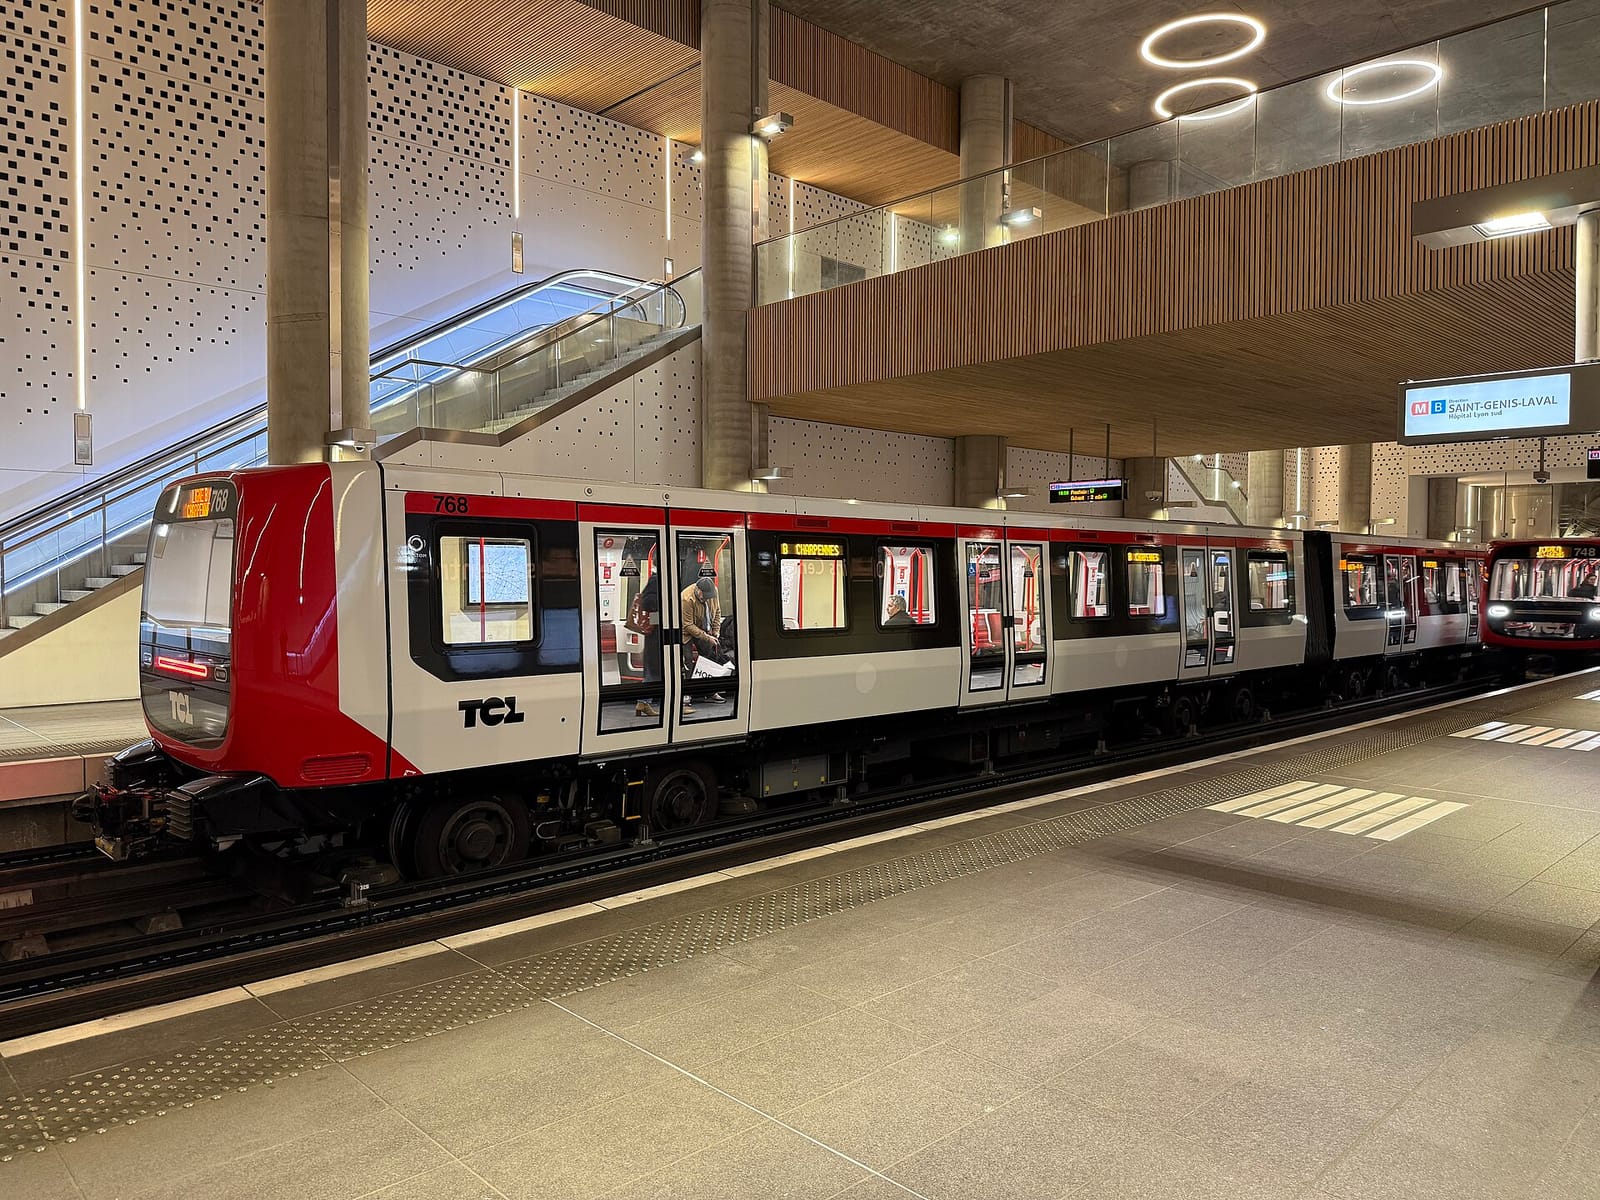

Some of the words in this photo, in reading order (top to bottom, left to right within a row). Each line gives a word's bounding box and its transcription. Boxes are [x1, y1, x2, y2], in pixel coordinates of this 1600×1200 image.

[1434, 402, 1442, 413] B
[1448, 395, 1558, 413] SAINT-GENIS-LAVAL
[210, 489, 229, 512] 768
[433, 495, 469, 514] 768
[782, 543, 789, 554] B
[795, 543, 840, 556] CHARPENNES
[1573, 547, 1596, 557] 748
[169, 690, 194, 725] TCL
[458, 696, 525, 728] TCL
